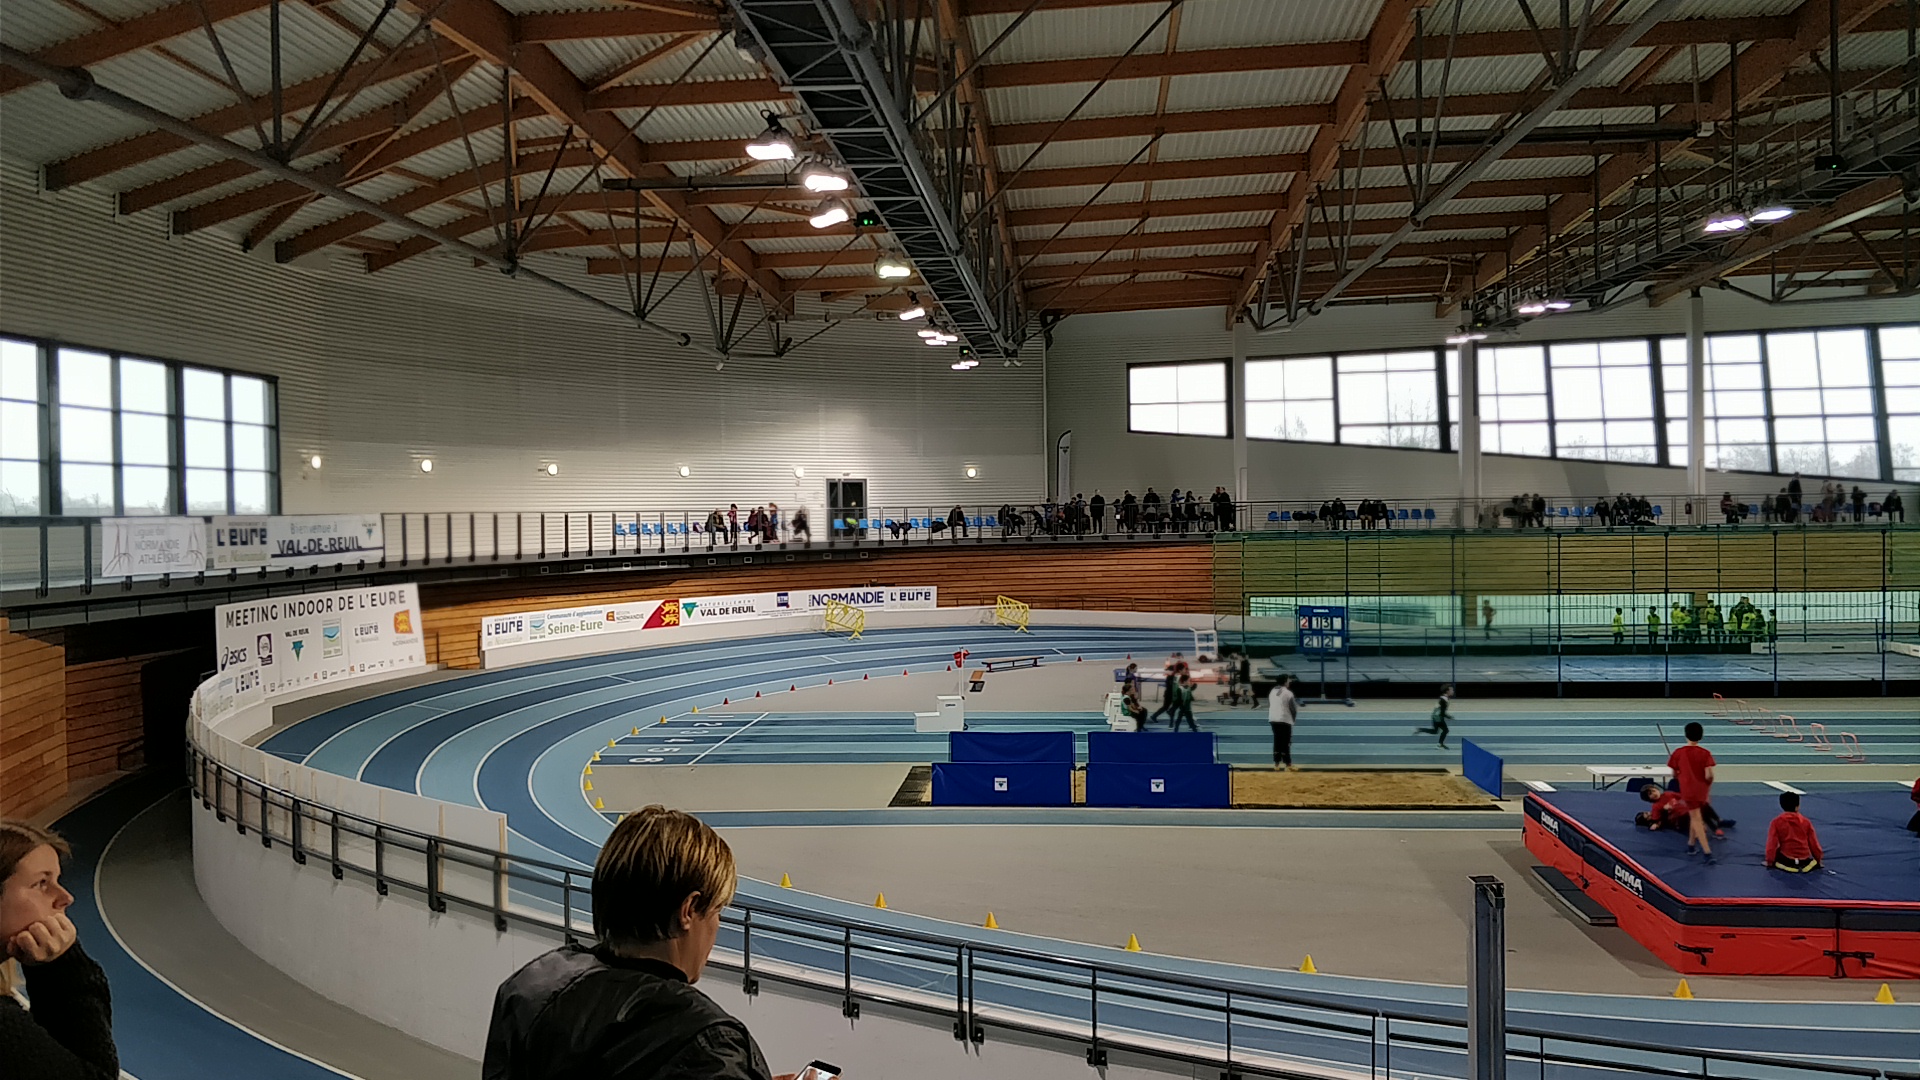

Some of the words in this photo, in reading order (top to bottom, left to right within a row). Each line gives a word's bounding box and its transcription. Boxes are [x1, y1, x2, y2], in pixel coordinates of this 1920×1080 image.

[277, 536, 362, 555] VAL-DE-REUIL
[226, 604, 278, 628] MEETING
[283, 598, 333, 619] INDOOR
[338, 595, 354, 611] DE
[359, 590, 406, 609] L'EURE
[700, 607, 718, 617] VAL
[719, 606, 730, 615] DE
[732, 605, 756, 614] REUIL
[547, 620, 603, 635] Seine-Eure
[1541, 811, 1559, 831] DIMA
[1614, 864, 1643, 891] DIMA
